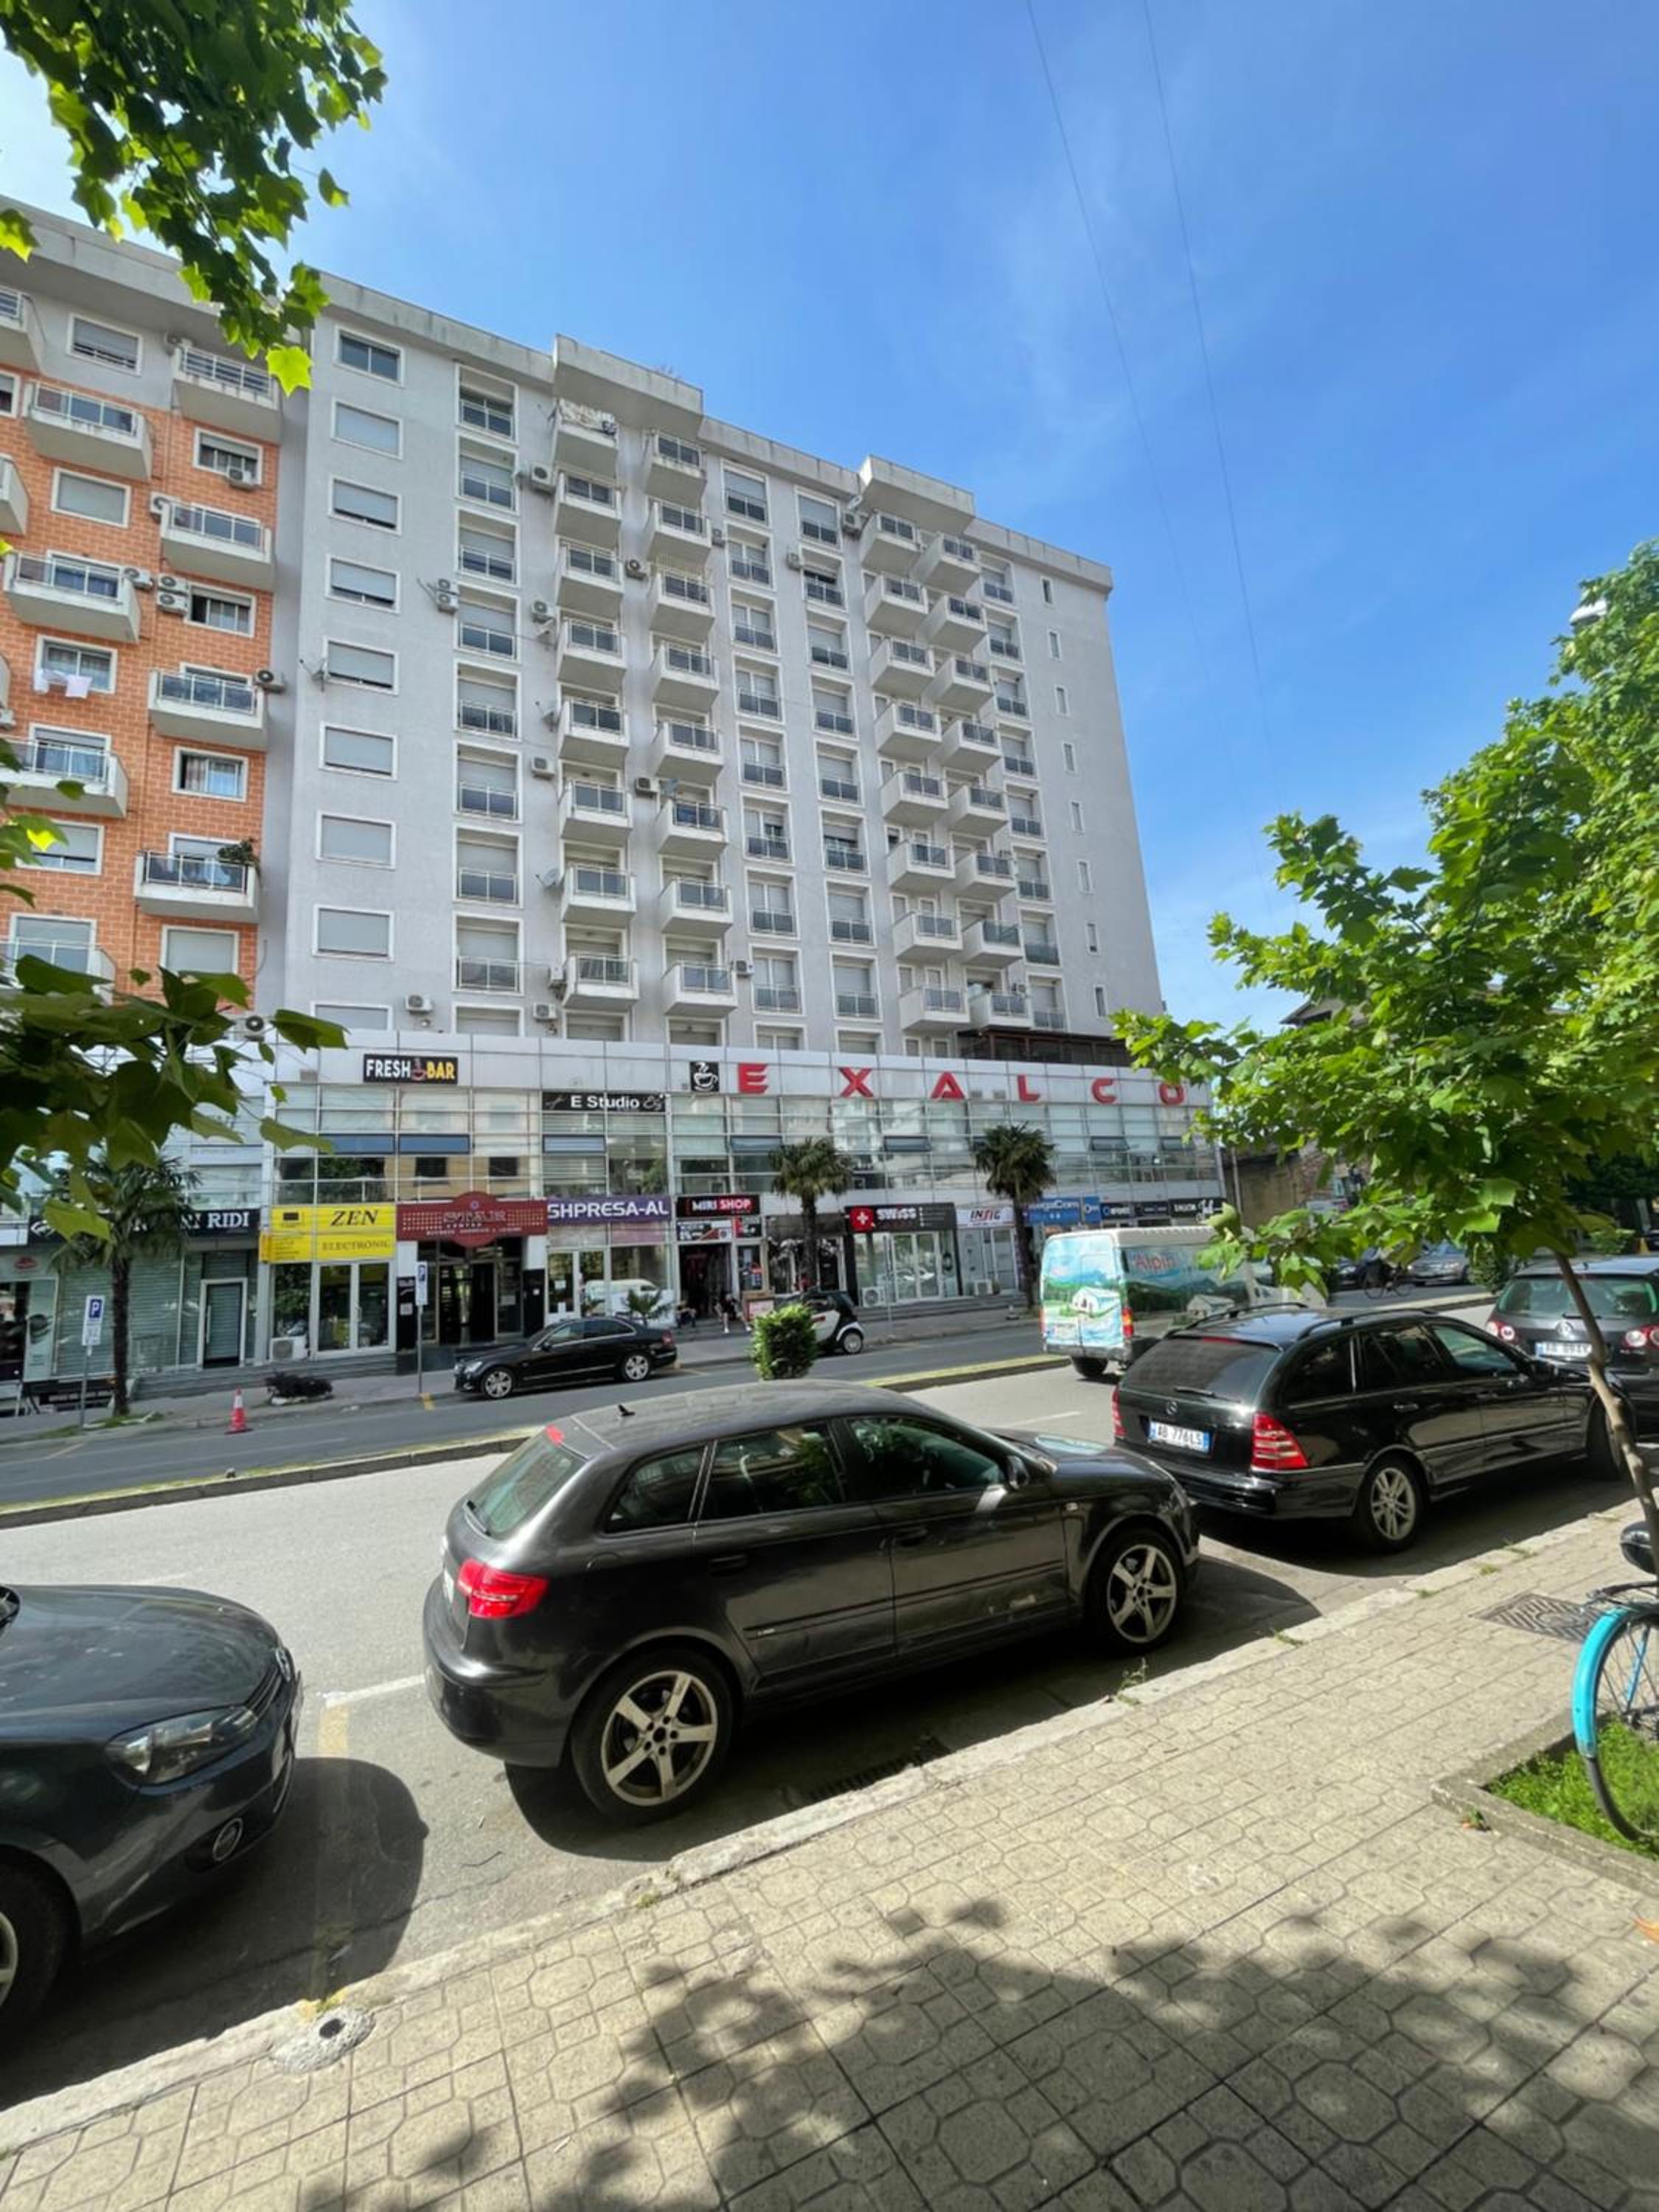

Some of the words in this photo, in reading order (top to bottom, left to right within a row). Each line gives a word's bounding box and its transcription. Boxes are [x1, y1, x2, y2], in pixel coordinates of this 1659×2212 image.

[366, 1059, 411, 1078] FRESH
[426, 1060, 456, 1080] BAR
[737, 1062, 1185, 1105] EXALCO
[570, 1095, 582, 1108] E
[587, 1095, 640, 1109] Studio
[547, 1200, 669, 1219] SHPRESA-AL
[719, 1197, 751, 1211] SHOP
[206, 1211, 250, 1230] RIDI
[330, 1208, 378, 1227] ZEN
[91, 1301, 100, 1316] P
